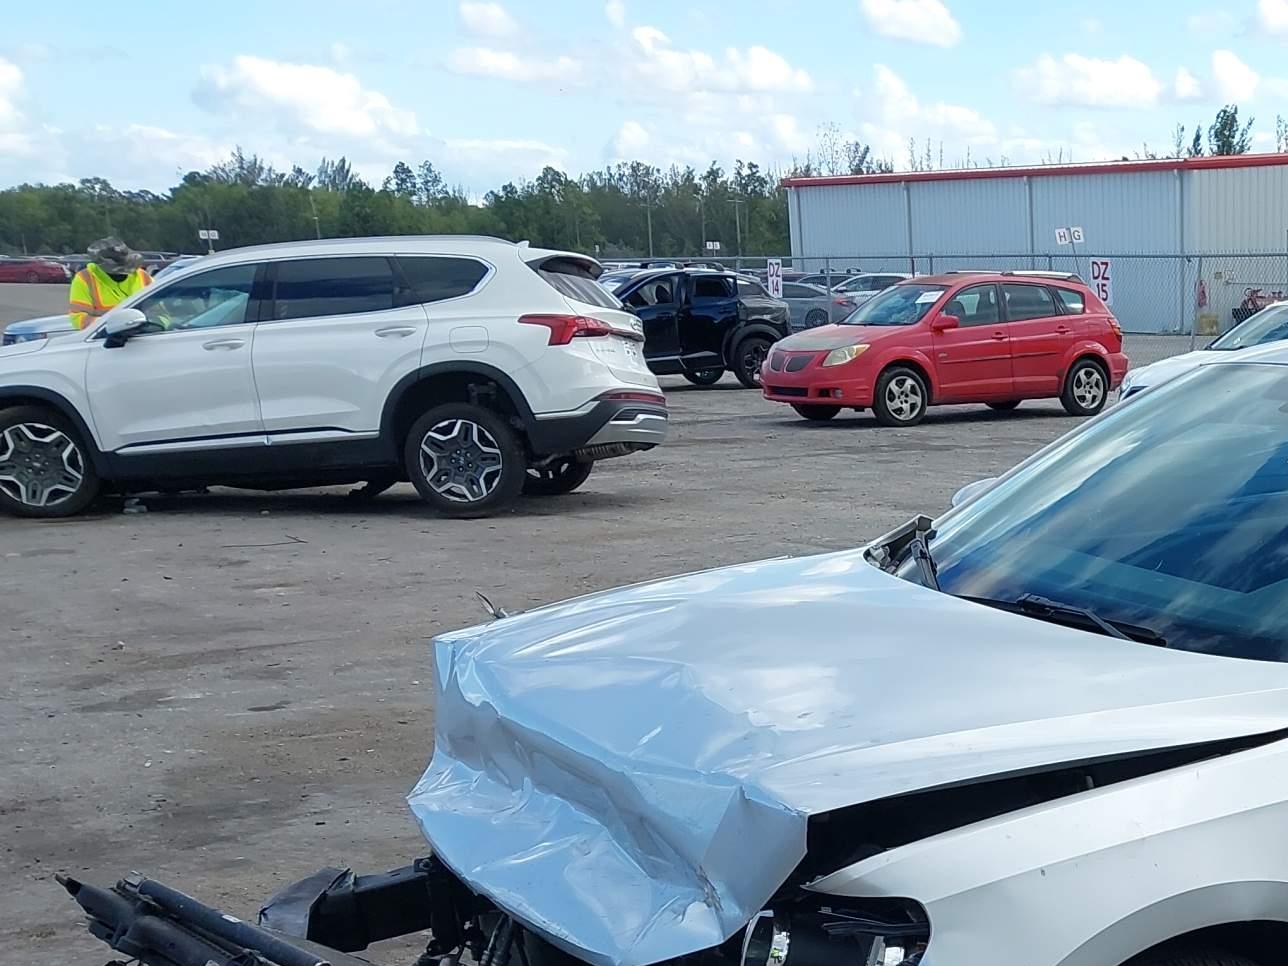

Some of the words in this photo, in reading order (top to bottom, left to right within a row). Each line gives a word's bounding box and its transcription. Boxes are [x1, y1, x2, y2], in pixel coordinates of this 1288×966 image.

[1058, 232, 1067, 243] H
[1072, 229, 1081, 241] G
[768, 262, 781, 278] DZ
[1091, 261, 1110, 281] DZ
[772, 279, 780, 295] 14
[1096, 283, 1108, 302] 15
